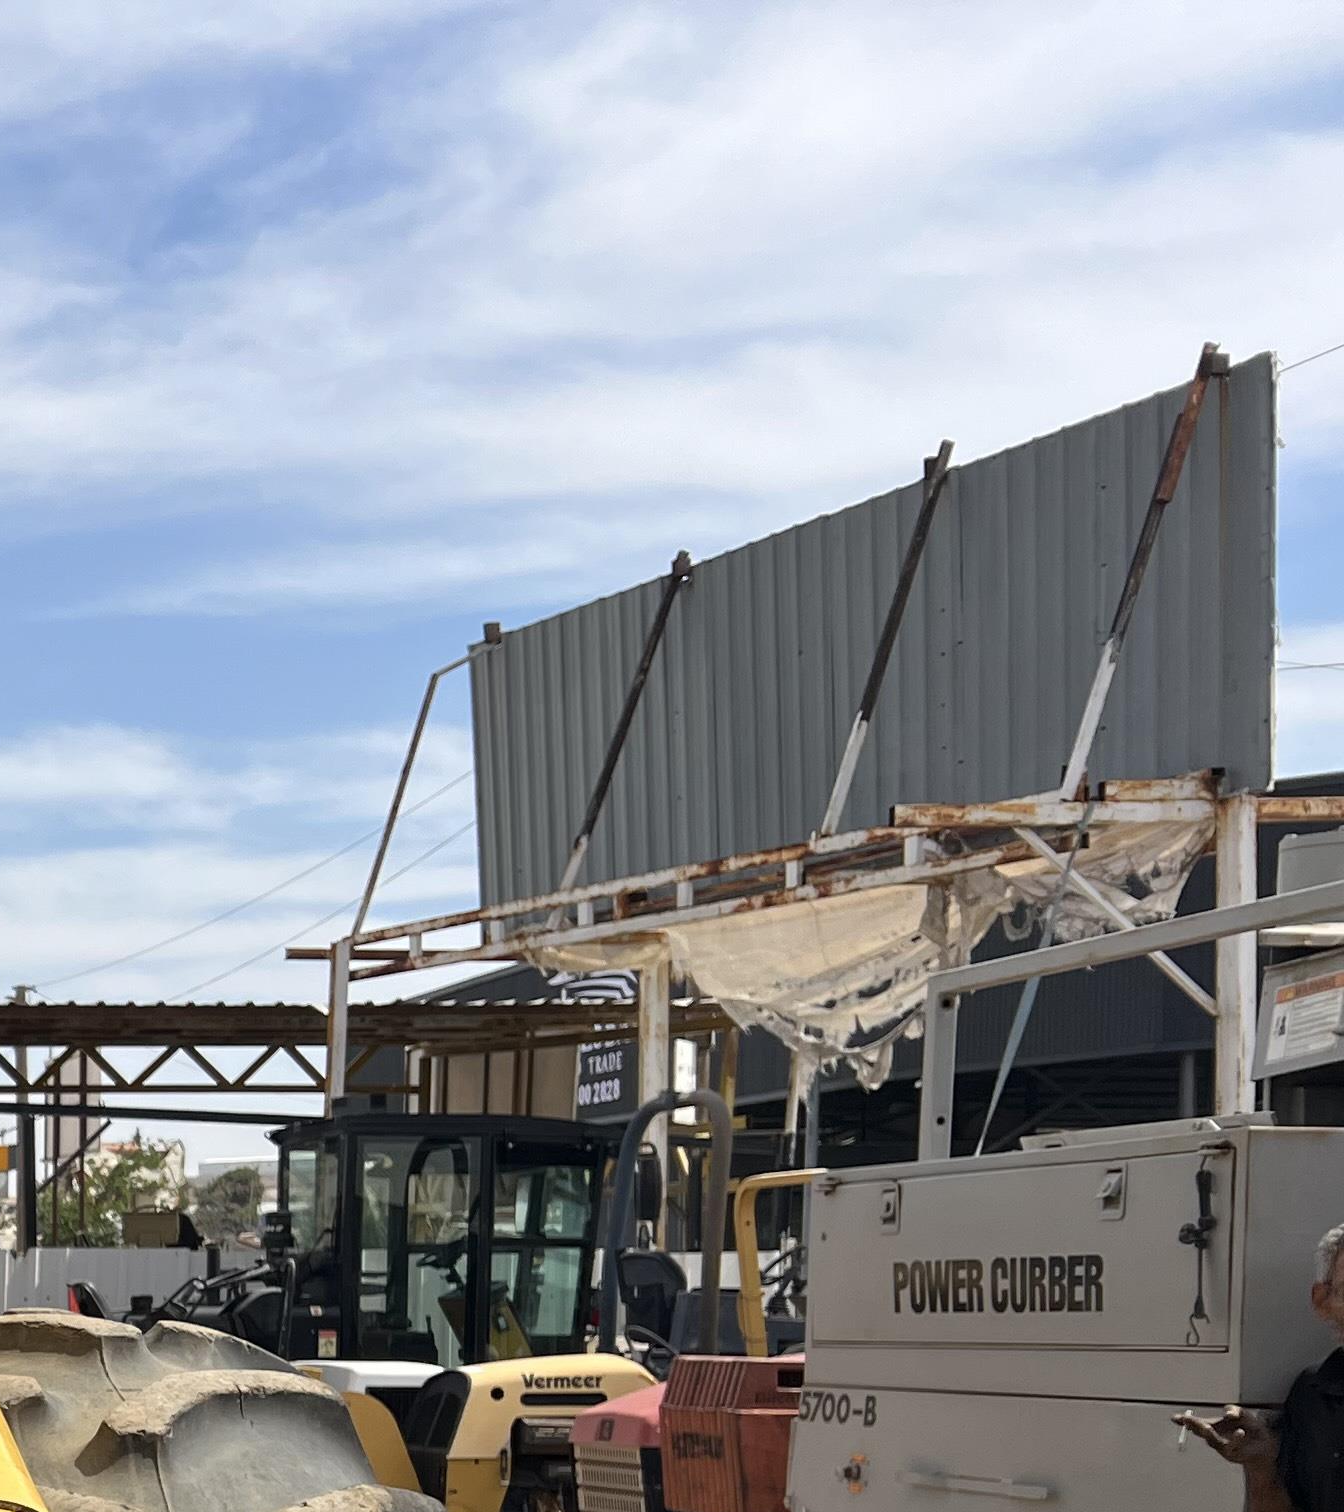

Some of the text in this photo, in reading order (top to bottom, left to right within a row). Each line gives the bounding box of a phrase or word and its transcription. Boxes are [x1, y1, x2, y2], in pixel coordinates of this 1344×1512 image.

[588, 1050, 622, 1075] TRADE
[893, 1254, 1104, 1314] POWER CURBER
[521, 1373, 603, 1389] Vermeer
[799, 1391, 877, 1426] 5700-B
